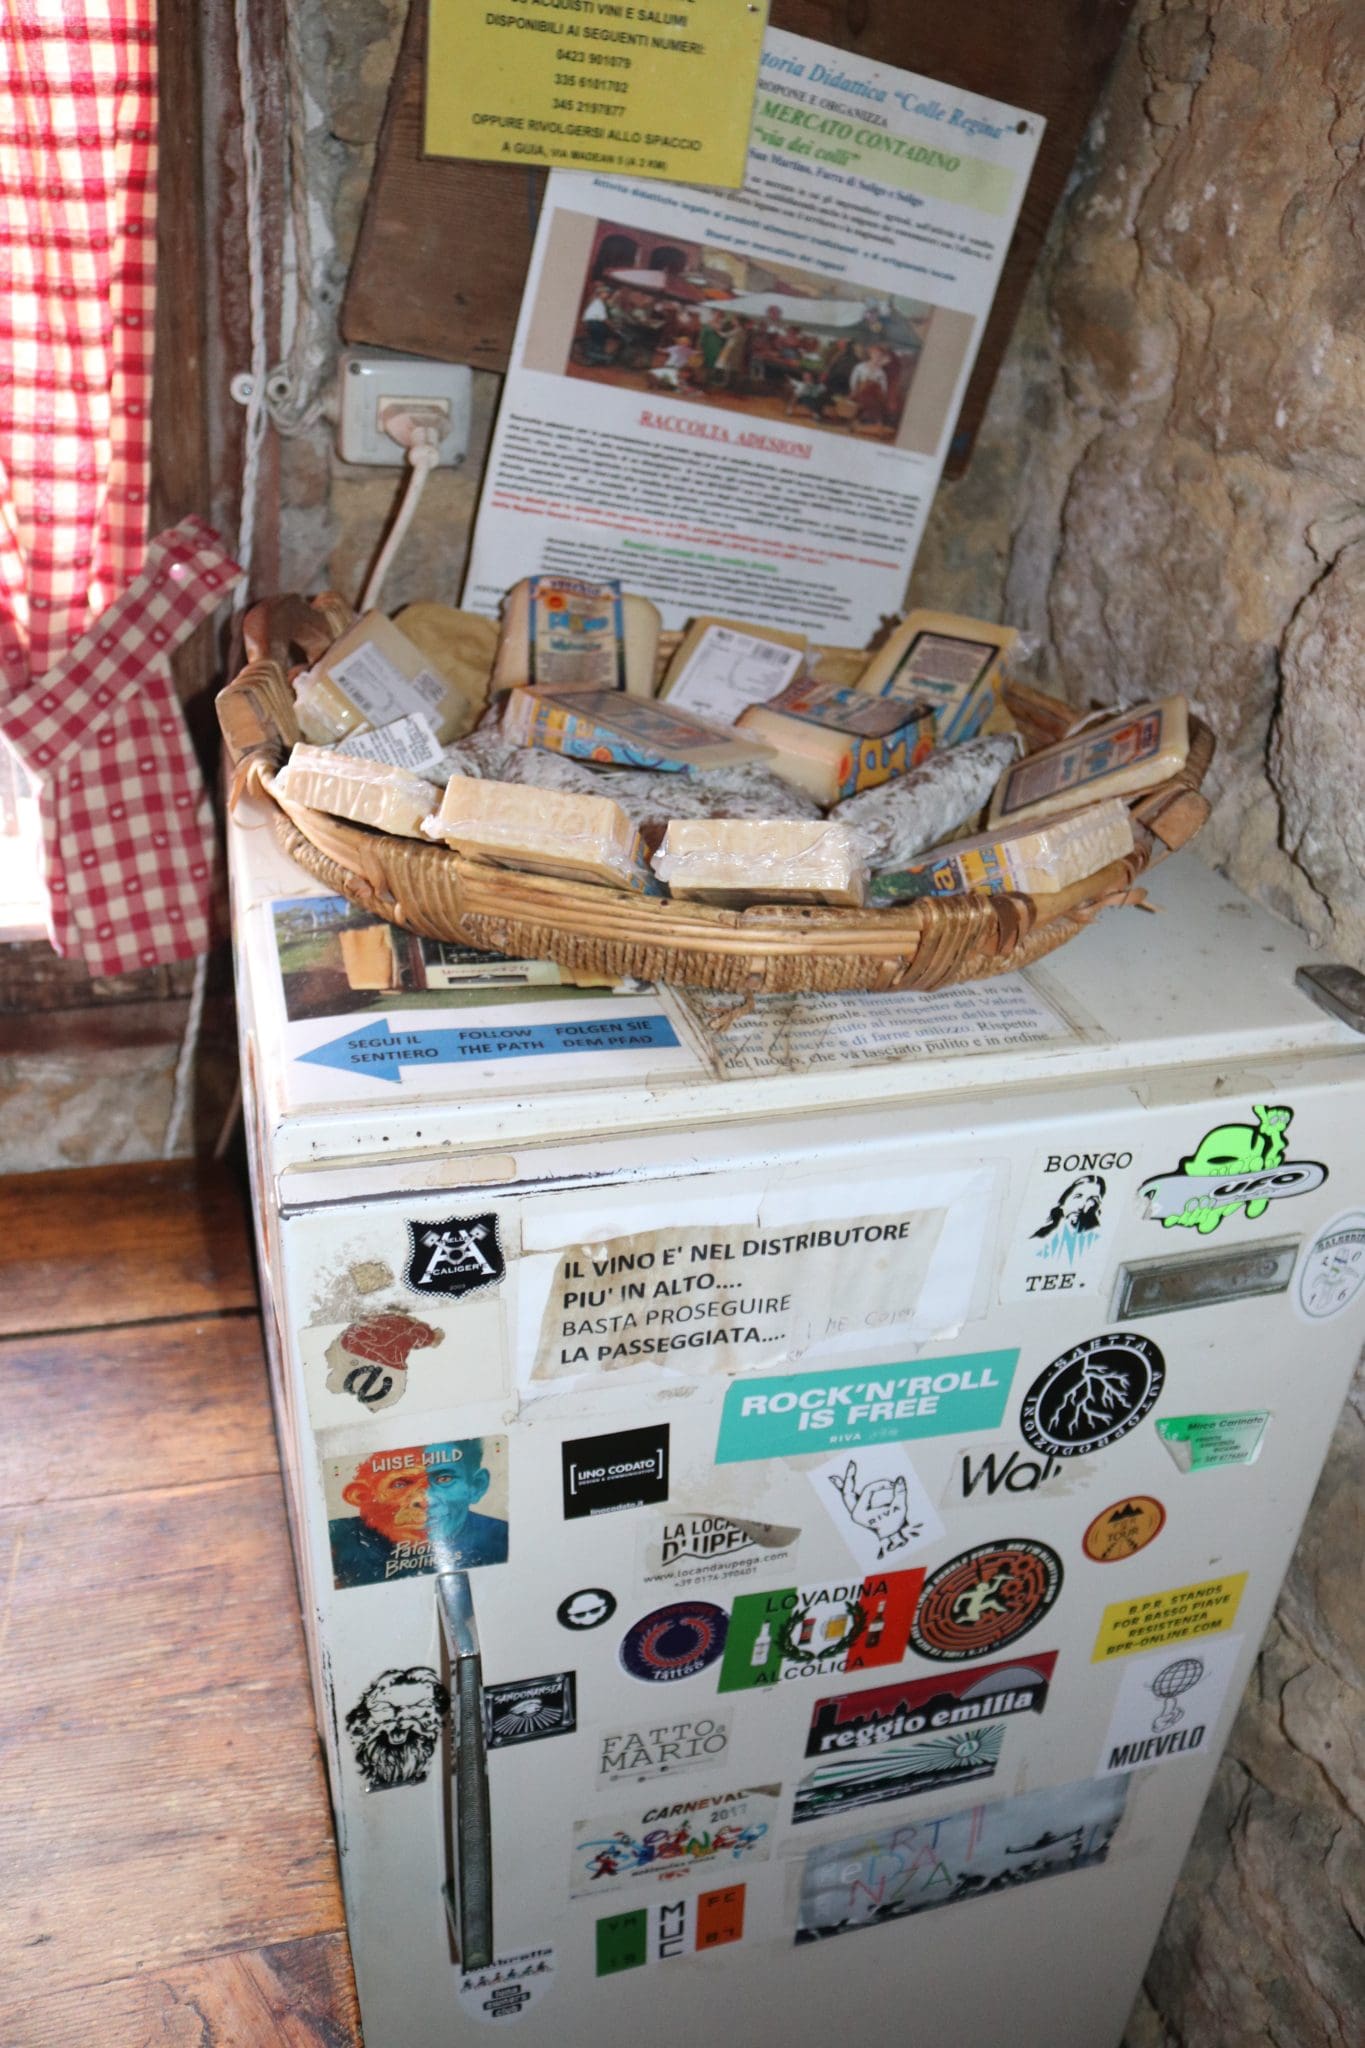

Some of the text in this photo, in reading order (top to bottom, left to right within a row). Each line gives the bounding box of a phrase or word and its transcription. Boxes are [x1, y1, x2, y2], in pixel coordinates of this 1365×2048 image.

[486, 13, 563, 35] DISPONIBILI
[566, 24, 580, 37] AI
[583, 27, 648, 47] SEGUENTI
[808, 63, 889, 103] Didattica
[757, 78, 805, 102] ROPONE
[819, 98, 888, 128] ORGANIZZA
[472, 112, 702, 151] OPPURE RIVOLGERSI ALLO SPACCIO
[760, 100, 960, 172] MERCATO CONTADINO
[502, 142, 510, 152] A
[788, 136, 813, 155] dei
[637, 410, 813, 458] RACCOLTA ADESIONI
[1001, 985, 1023, 994] via
[870, 1007, 890, 1017] nel
[895, 1001, 950, 1015] rispetto
[954, 998, 975, 1009] del
[978, 996, 1028, 1007] Valore
[870, 1018, 886, 1028] al
[889, 1015, 958, 1027] momento
[962, 1009, 997, 1021] della
[459, 1029, 532, 1040] FOLLOW
[556, 1021, 652, 1035] FOLGEN SIE
[851, 1033, 868, 1046] di
[872, 1031, 911, 1044] farne
[976, 1019, 1038, 1032] Rispetto
[348, 1035, 421, 1049] SEGUI IL
[458, 1041, 545, 1055] THE PATH
[562, 1035, 653, 1048] DEM PFAD
[724, 1056, 749, 1070] del
[809, 1052, 837, 1064] che
[863, 1042, 922, 1059] lasciato
[925, 1038, 970, 1054] pulito
[975, 1038, 983, 1047] e
[985, 1035, 1001, 1046] in
[351, 1048, 439, 1064] SENTIERO
[1043, 1152, 1133, 1173] BONGO
[1213, 1172, 1305, 1198] UFO
[564, 1222, 910, 1279] IL VINO E' NEL DISTRIBUTORE
[564, 1273, 742, 1309] PIU' IN ALTO....
[1025, 1273, 1086, 1293] TEE.
[563, 1294, 792, 1337] BASTA PROSEGUIRE
[561, 1347, 589, 1364] LA
[1054, 1335, 1148, 1370] SAETTA
[740, 1368, 998, 1417] ROCK'N'ROLL
[798, 1396, 940, 1431] IS FREE
[829, 1432, 862, 1444] RIVA
[372, 1449, 463, 1472] WISE WILD
[578, 1459, 656, 1480] LINO CODATO
[664, 1517, 739, 1540] LA LOCA
[868, 1506, 901, 1526] RIVA
[643, 1552, 788, 1583] www.locandaupega.com
[766, 1581, 888, 1614] LOVADINA
[1170, 1584, 1223, 1604] STANDS
[1113, 1594, 1231, 1630] FOR BASSO PIAVE
[1128, 1612, 1208, 1637] RESISTENZA
[755, 1656, 865, 1685] ALCOLICA
[820, 1690, 1034, 1752] reggio emilia
[602, 1720, 714, 1755] FATTO
[1107, 1725, 1206, 1770] MUEVELO
[600, 1734, 727, 1774] MARIO
